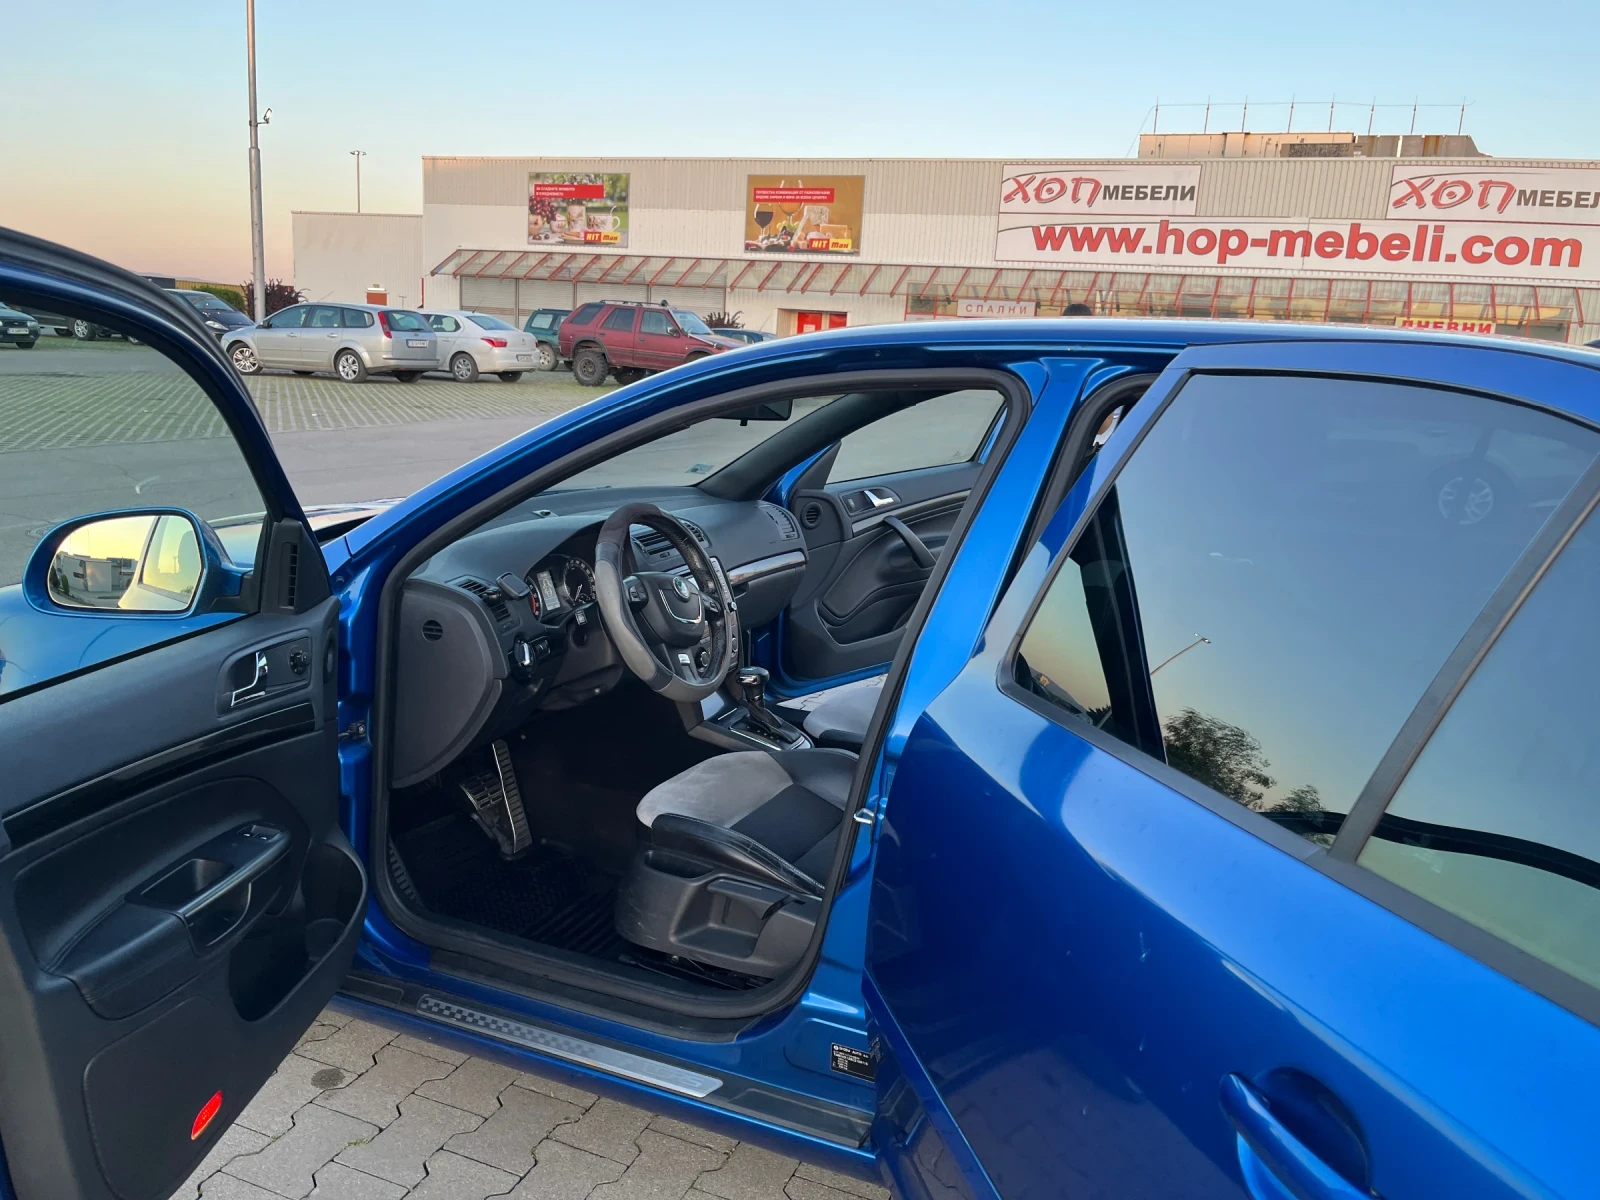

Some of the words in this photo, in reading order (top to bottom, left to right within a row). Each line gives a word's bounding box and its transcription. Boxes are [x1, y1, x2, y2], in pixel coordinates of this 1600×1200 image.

[1003, 174, 1103, 207] ХОП
[1102, 184, 1196, 201] МЕБЕЛИ
[1392, 176, 1517, 214] ХОП
[812, 240, 828, 248] HIT
[1031, 220, 1583, 268] www.hop-mebeli.com
[965, 304, 1027, 315] СПАЛНИ
